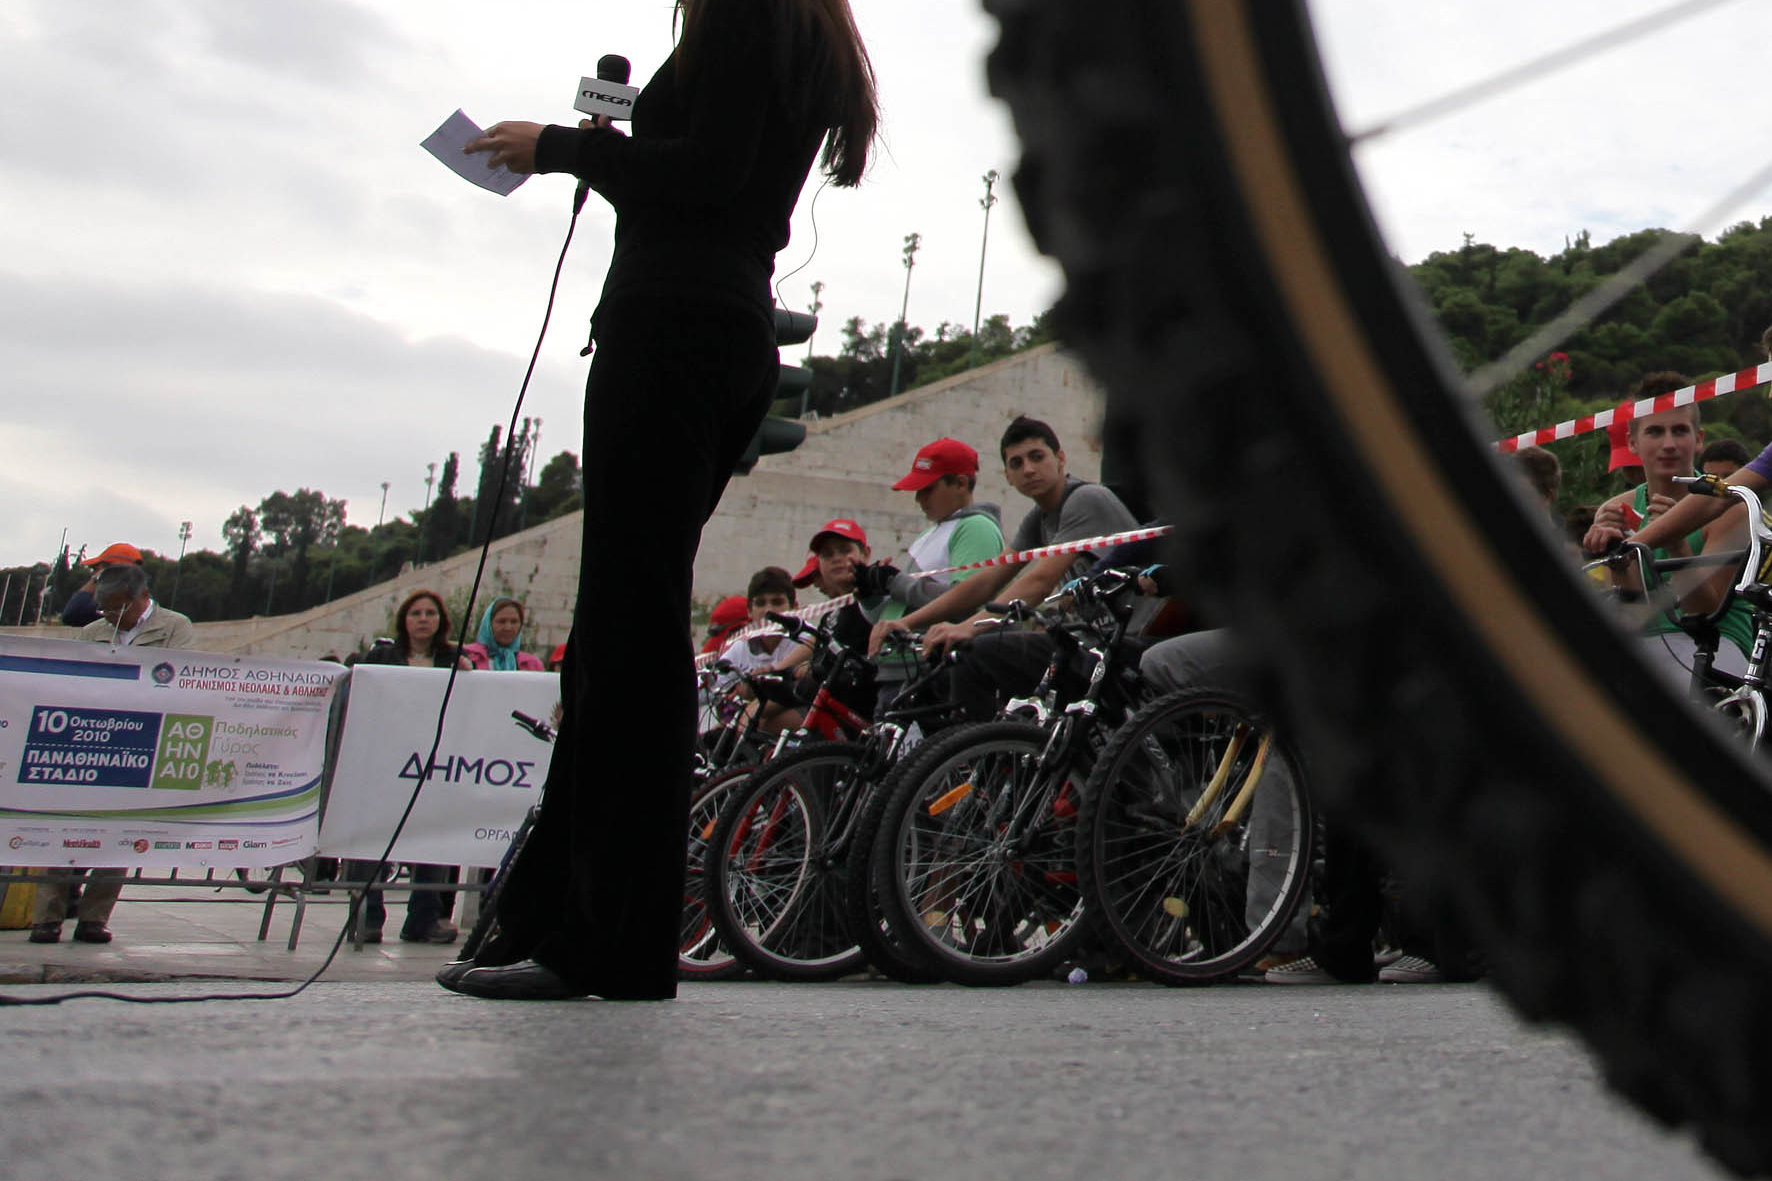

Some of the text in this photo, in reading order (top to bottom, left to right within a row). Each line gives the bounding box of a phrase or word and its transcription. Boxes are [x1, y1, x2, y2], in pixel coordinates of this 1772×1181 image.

[179, 665, 335, 685] ΔΗΜΟΣ ΑΘΗΝΑΙΩΝ
[178, 679, 237, 692] ΟΡΓΑΝΙΣΜΟΣ
[239, 682, 282, 695] ΝΕΟΛΑΙΑΣ
[37, 710, 144, 733] 10 Οκτωβρίου
[167, 721, 204, 739] ΑΘ
[72, 730, 111, 743] 2010
[26, 750, 149, 769] ΠΑΝΑΘΗΝΑΪΚΟ
[164, 741, 202, 760] ΗΝ
[27, 767, 98, 782] ΣΤΑΔΙΟ
[398, 751, 536, 788] ΔΗΜΟΣ
[242, 840, 268, 849] Glam
